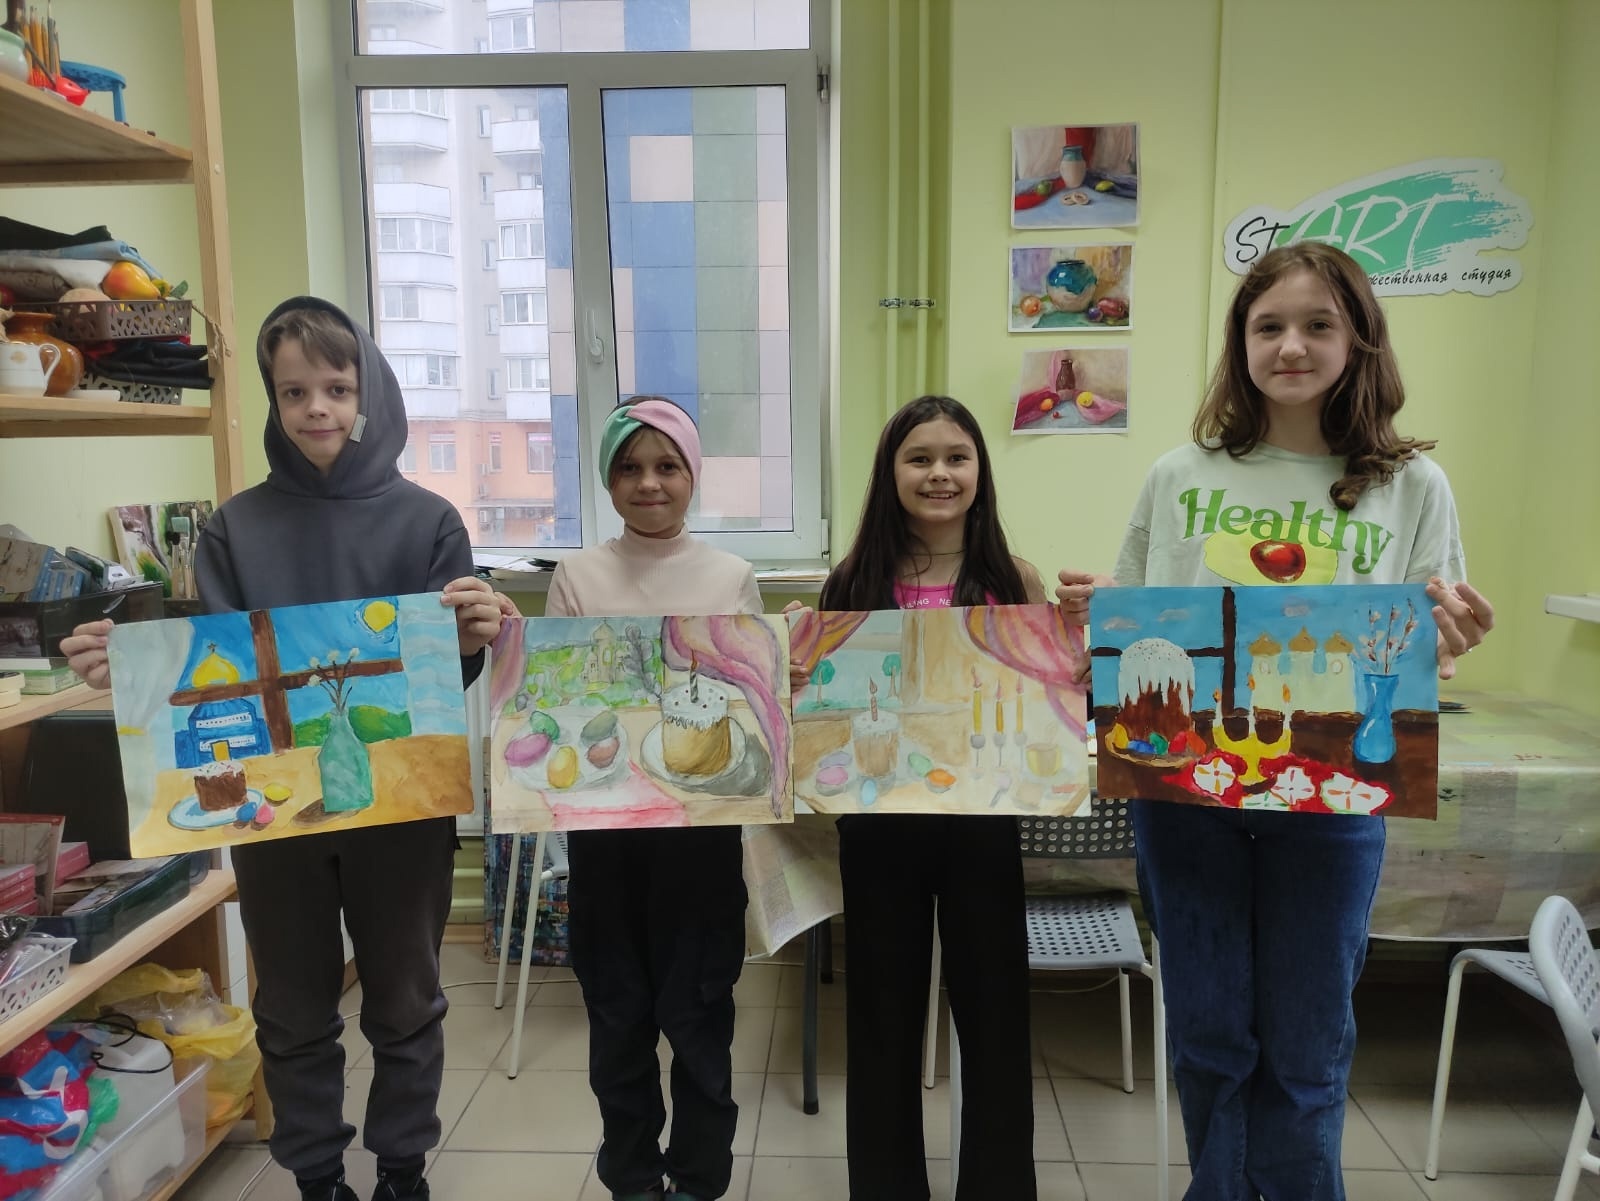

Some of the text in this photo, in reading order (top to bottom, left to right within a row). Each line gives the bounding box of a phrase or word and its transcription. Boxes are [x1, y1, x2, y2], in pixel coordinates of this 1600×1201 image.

[1369, 267, 1512, 286] жественная студия
[1178, 487, 1395, 575] Healthy
